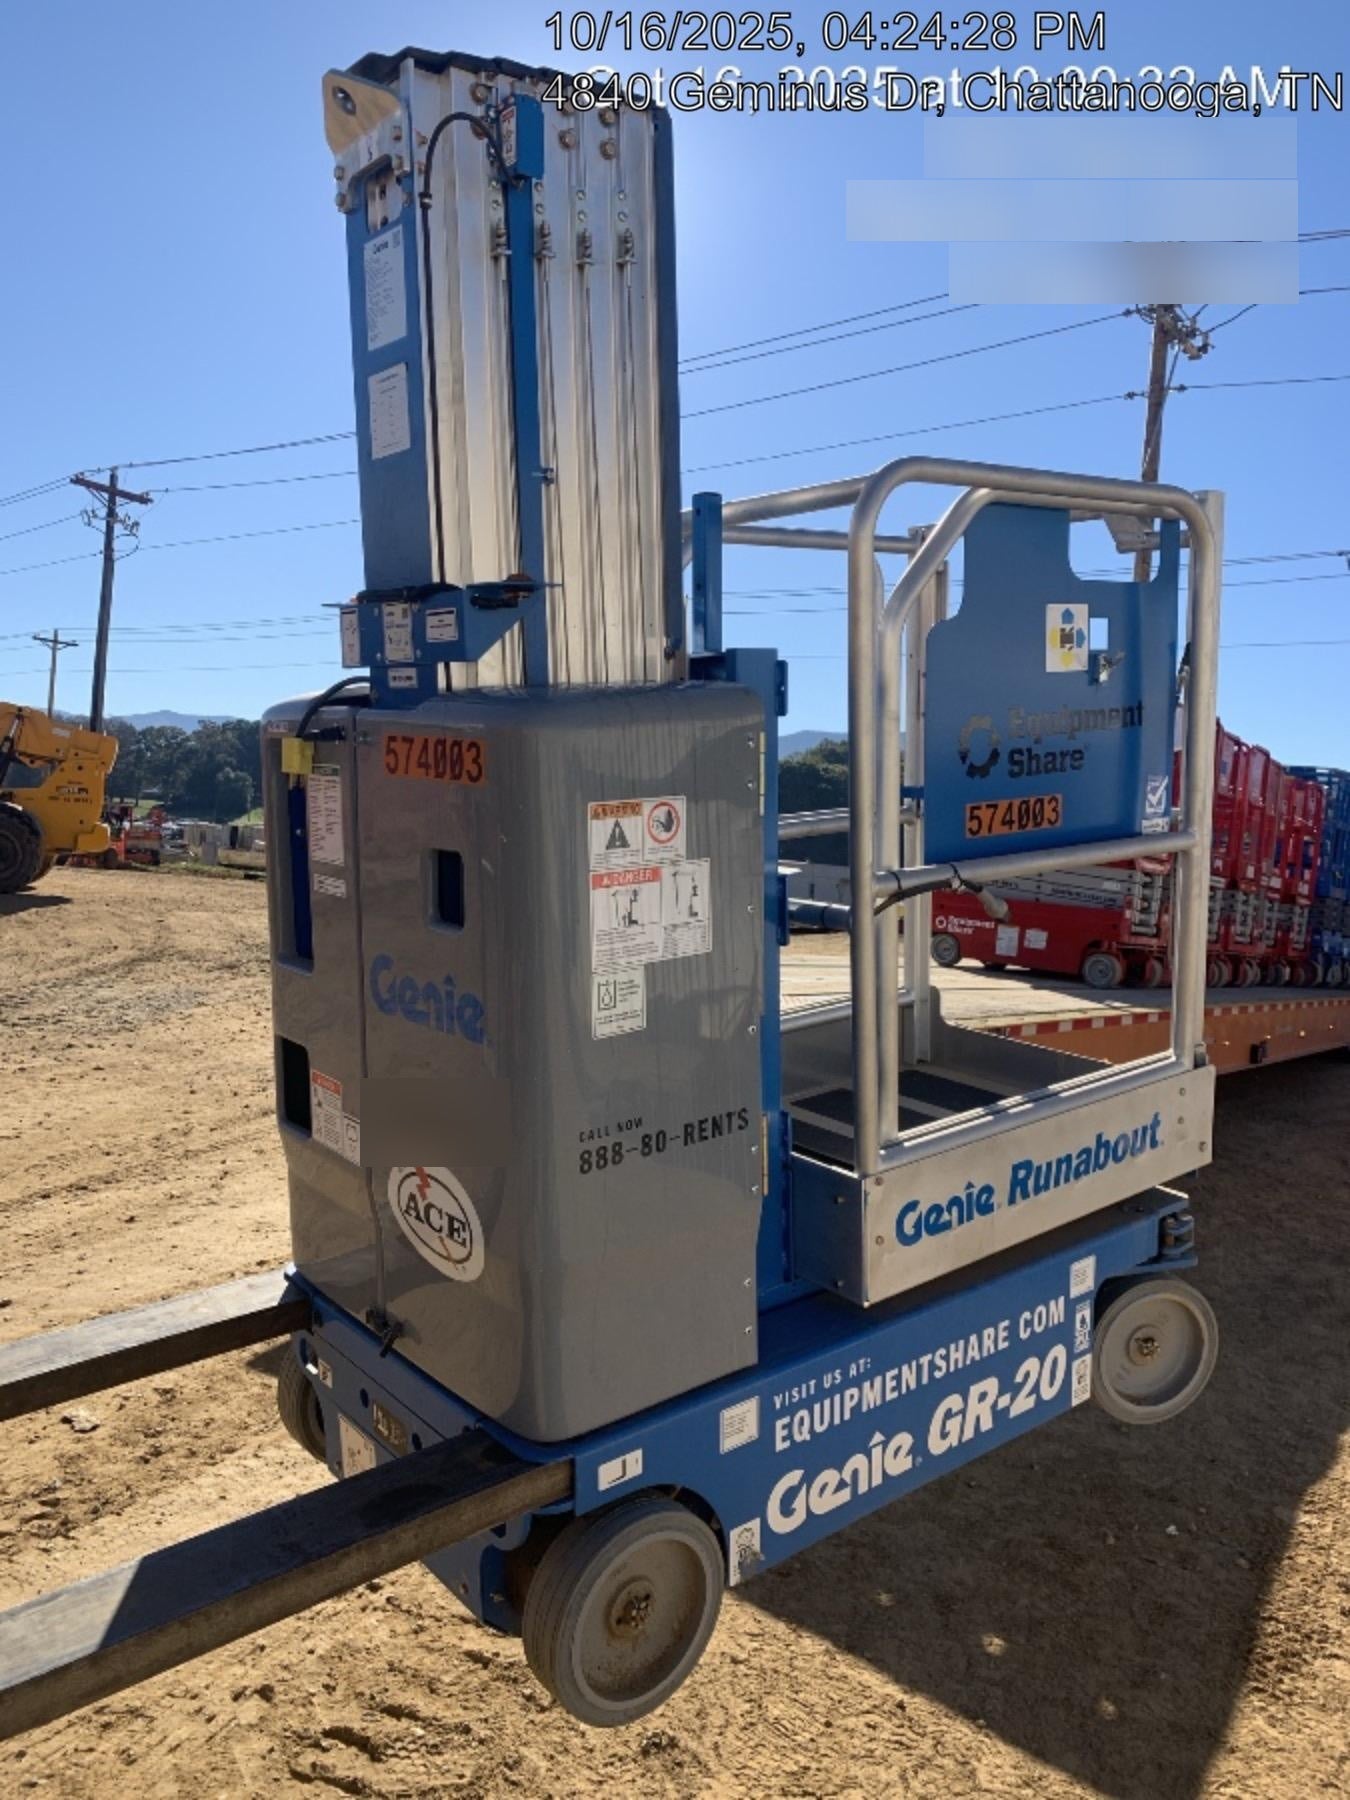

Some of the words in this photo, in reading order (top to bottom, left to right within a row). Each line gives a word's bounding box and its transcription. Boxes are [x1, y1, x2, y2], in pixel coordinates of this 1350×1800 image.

[1007, 700, 1144, 743] Equipment
[385, 735, 483, 783] 574003
[1007, 748, 1086, 779] Share
[967, 795, 1061, 837] 574003
[369, 952, 486, 1045] Genie
[579, 1126, 611, 1143] CALL
[616, 1116, 644, 1133] NOW
[579, 1107, 750, 1175] 888-80-RENTS
[895, 1181, 996, 1247] Genie
[1007, 1111, 1161, 1207] Runabout
[403, 1191, 468, 1249] ACE
[773, 1379, 817, 1411] VISIT
[823, 1369, 843, 1389] US
[849, 1357, 872, 1379] AT:
[766, 1430, 915, 1536] Genie
[926, 1343, 1068, 1457] GR-20
